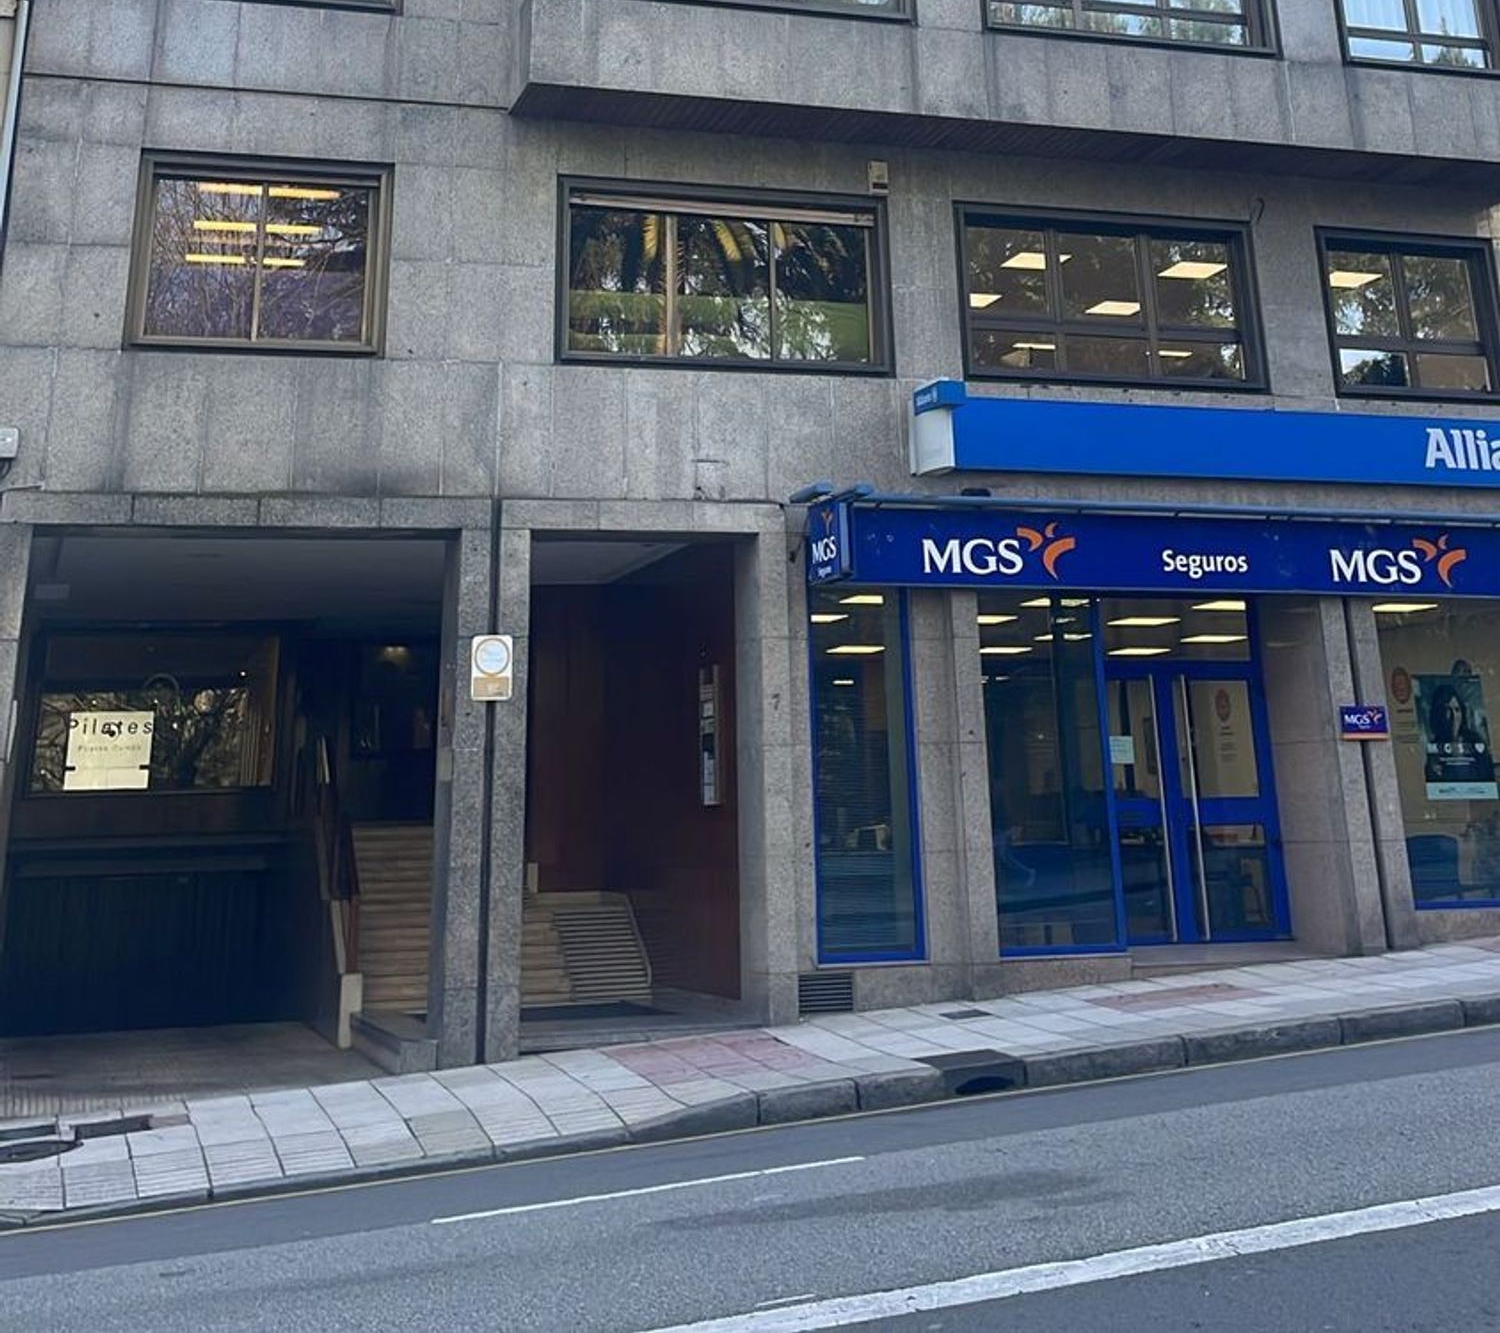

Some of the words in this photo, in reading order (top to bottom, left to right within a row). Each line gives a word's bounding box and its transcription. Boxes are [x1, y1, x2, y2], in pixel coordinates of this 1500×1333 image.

[812, 535, 837, 564] MGS
[922, 538, 1024, 575] MGS
[1162, 549, 1248, 579] Seguros
[1329, 549, 1422, 584] MGS
[69, 717, 153, 736] Pilates
[1344, 714, 1371, 725] MGS
